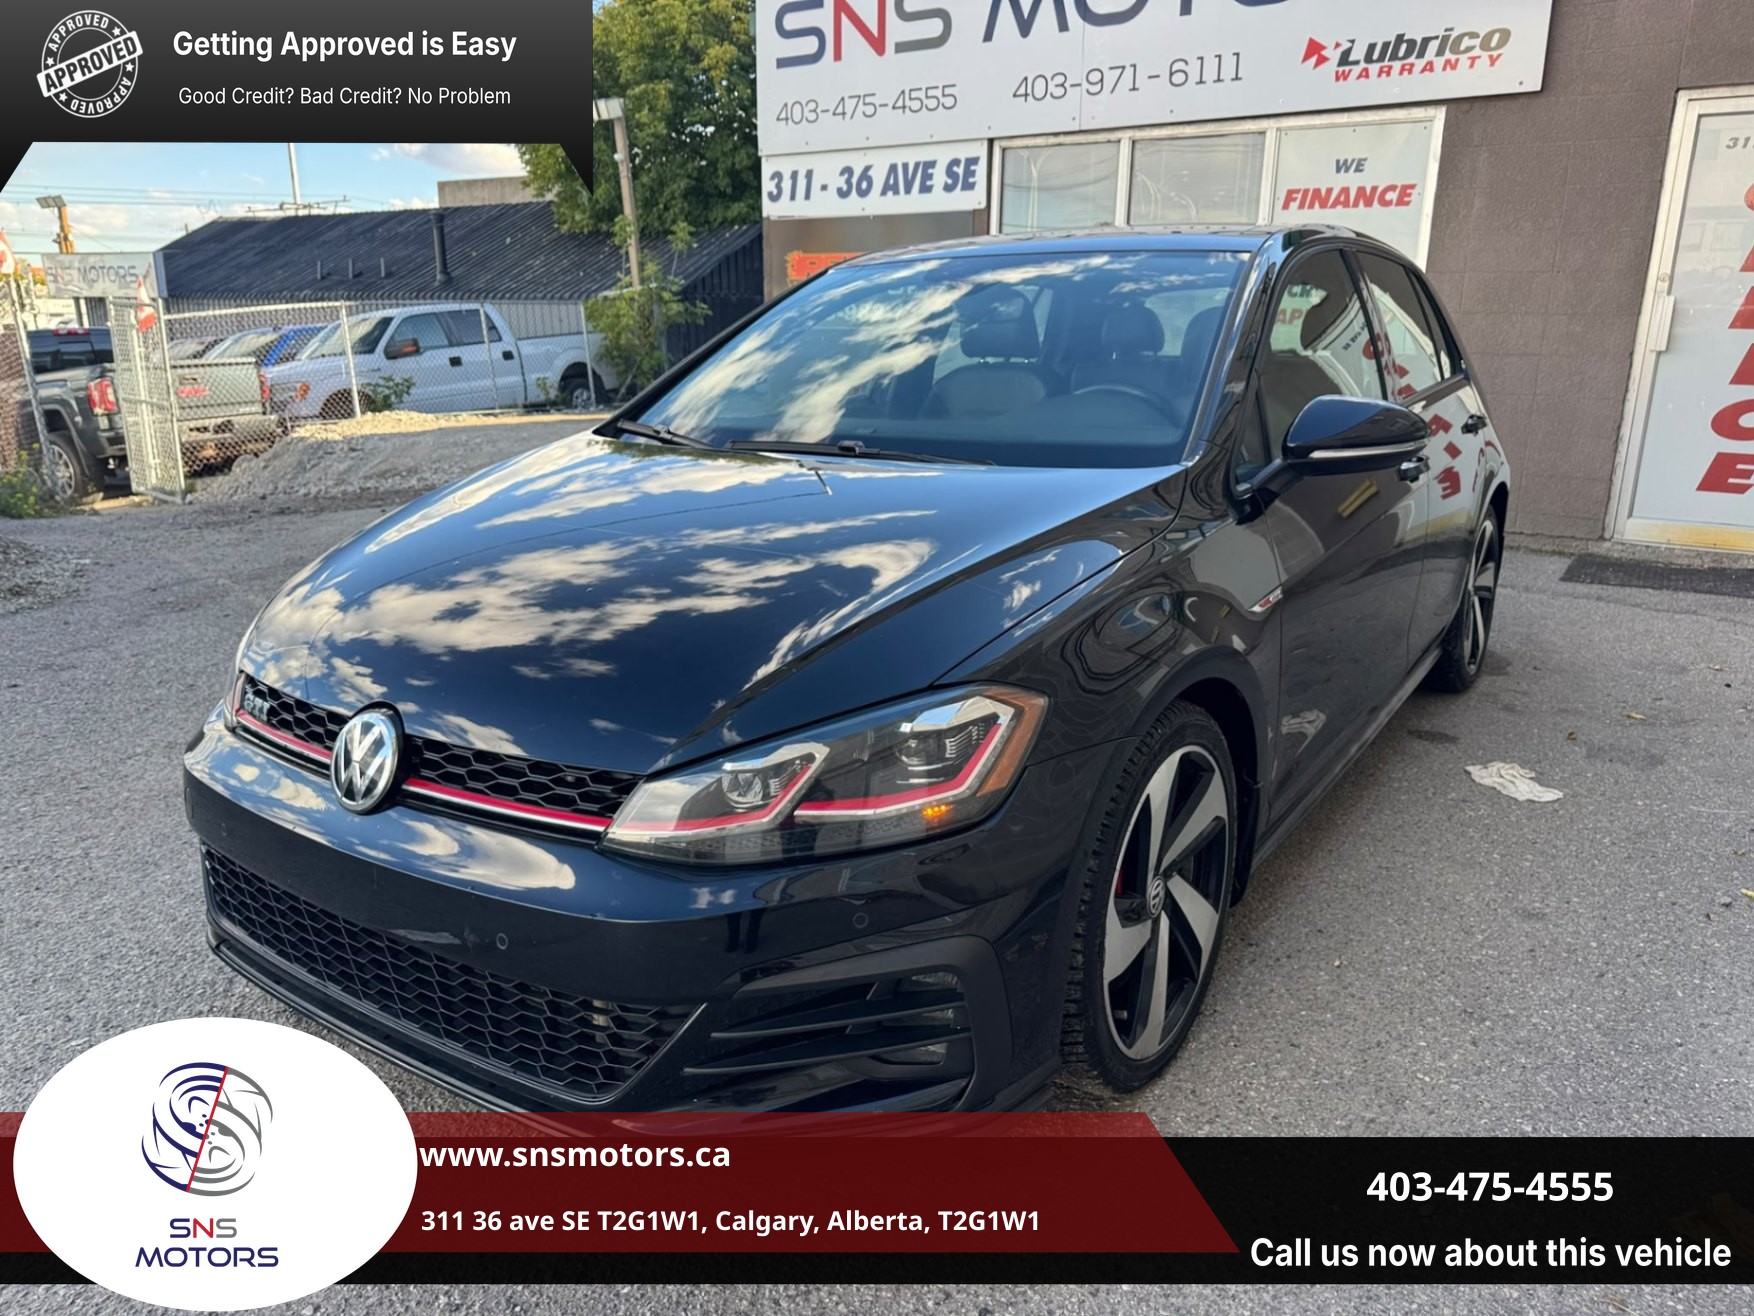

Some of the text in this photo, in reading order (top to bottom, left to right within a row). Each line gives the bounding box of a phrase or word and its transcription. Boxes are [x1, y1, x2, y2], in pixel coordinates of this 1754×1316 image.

[774, 0, 953, 69] SNS
[1335, 26, 1513, 69] Lubrico
[1333, 52, 1504, 83] WARRANTY
[775, 83, 958, 127] 403-475-4555
[1725, 135, 1754, 150] 31
[766, 169, 814, 204] 311
[836, 164, 874, 199] 36
[879, 159, 938, 197] AVE
[942, 156, 986, 194] SE
[1335, 157, 1369, 175] WE
[1280, 183, 1418, 212] FINANCE
[77, 264, 138, 284] MOTORS
